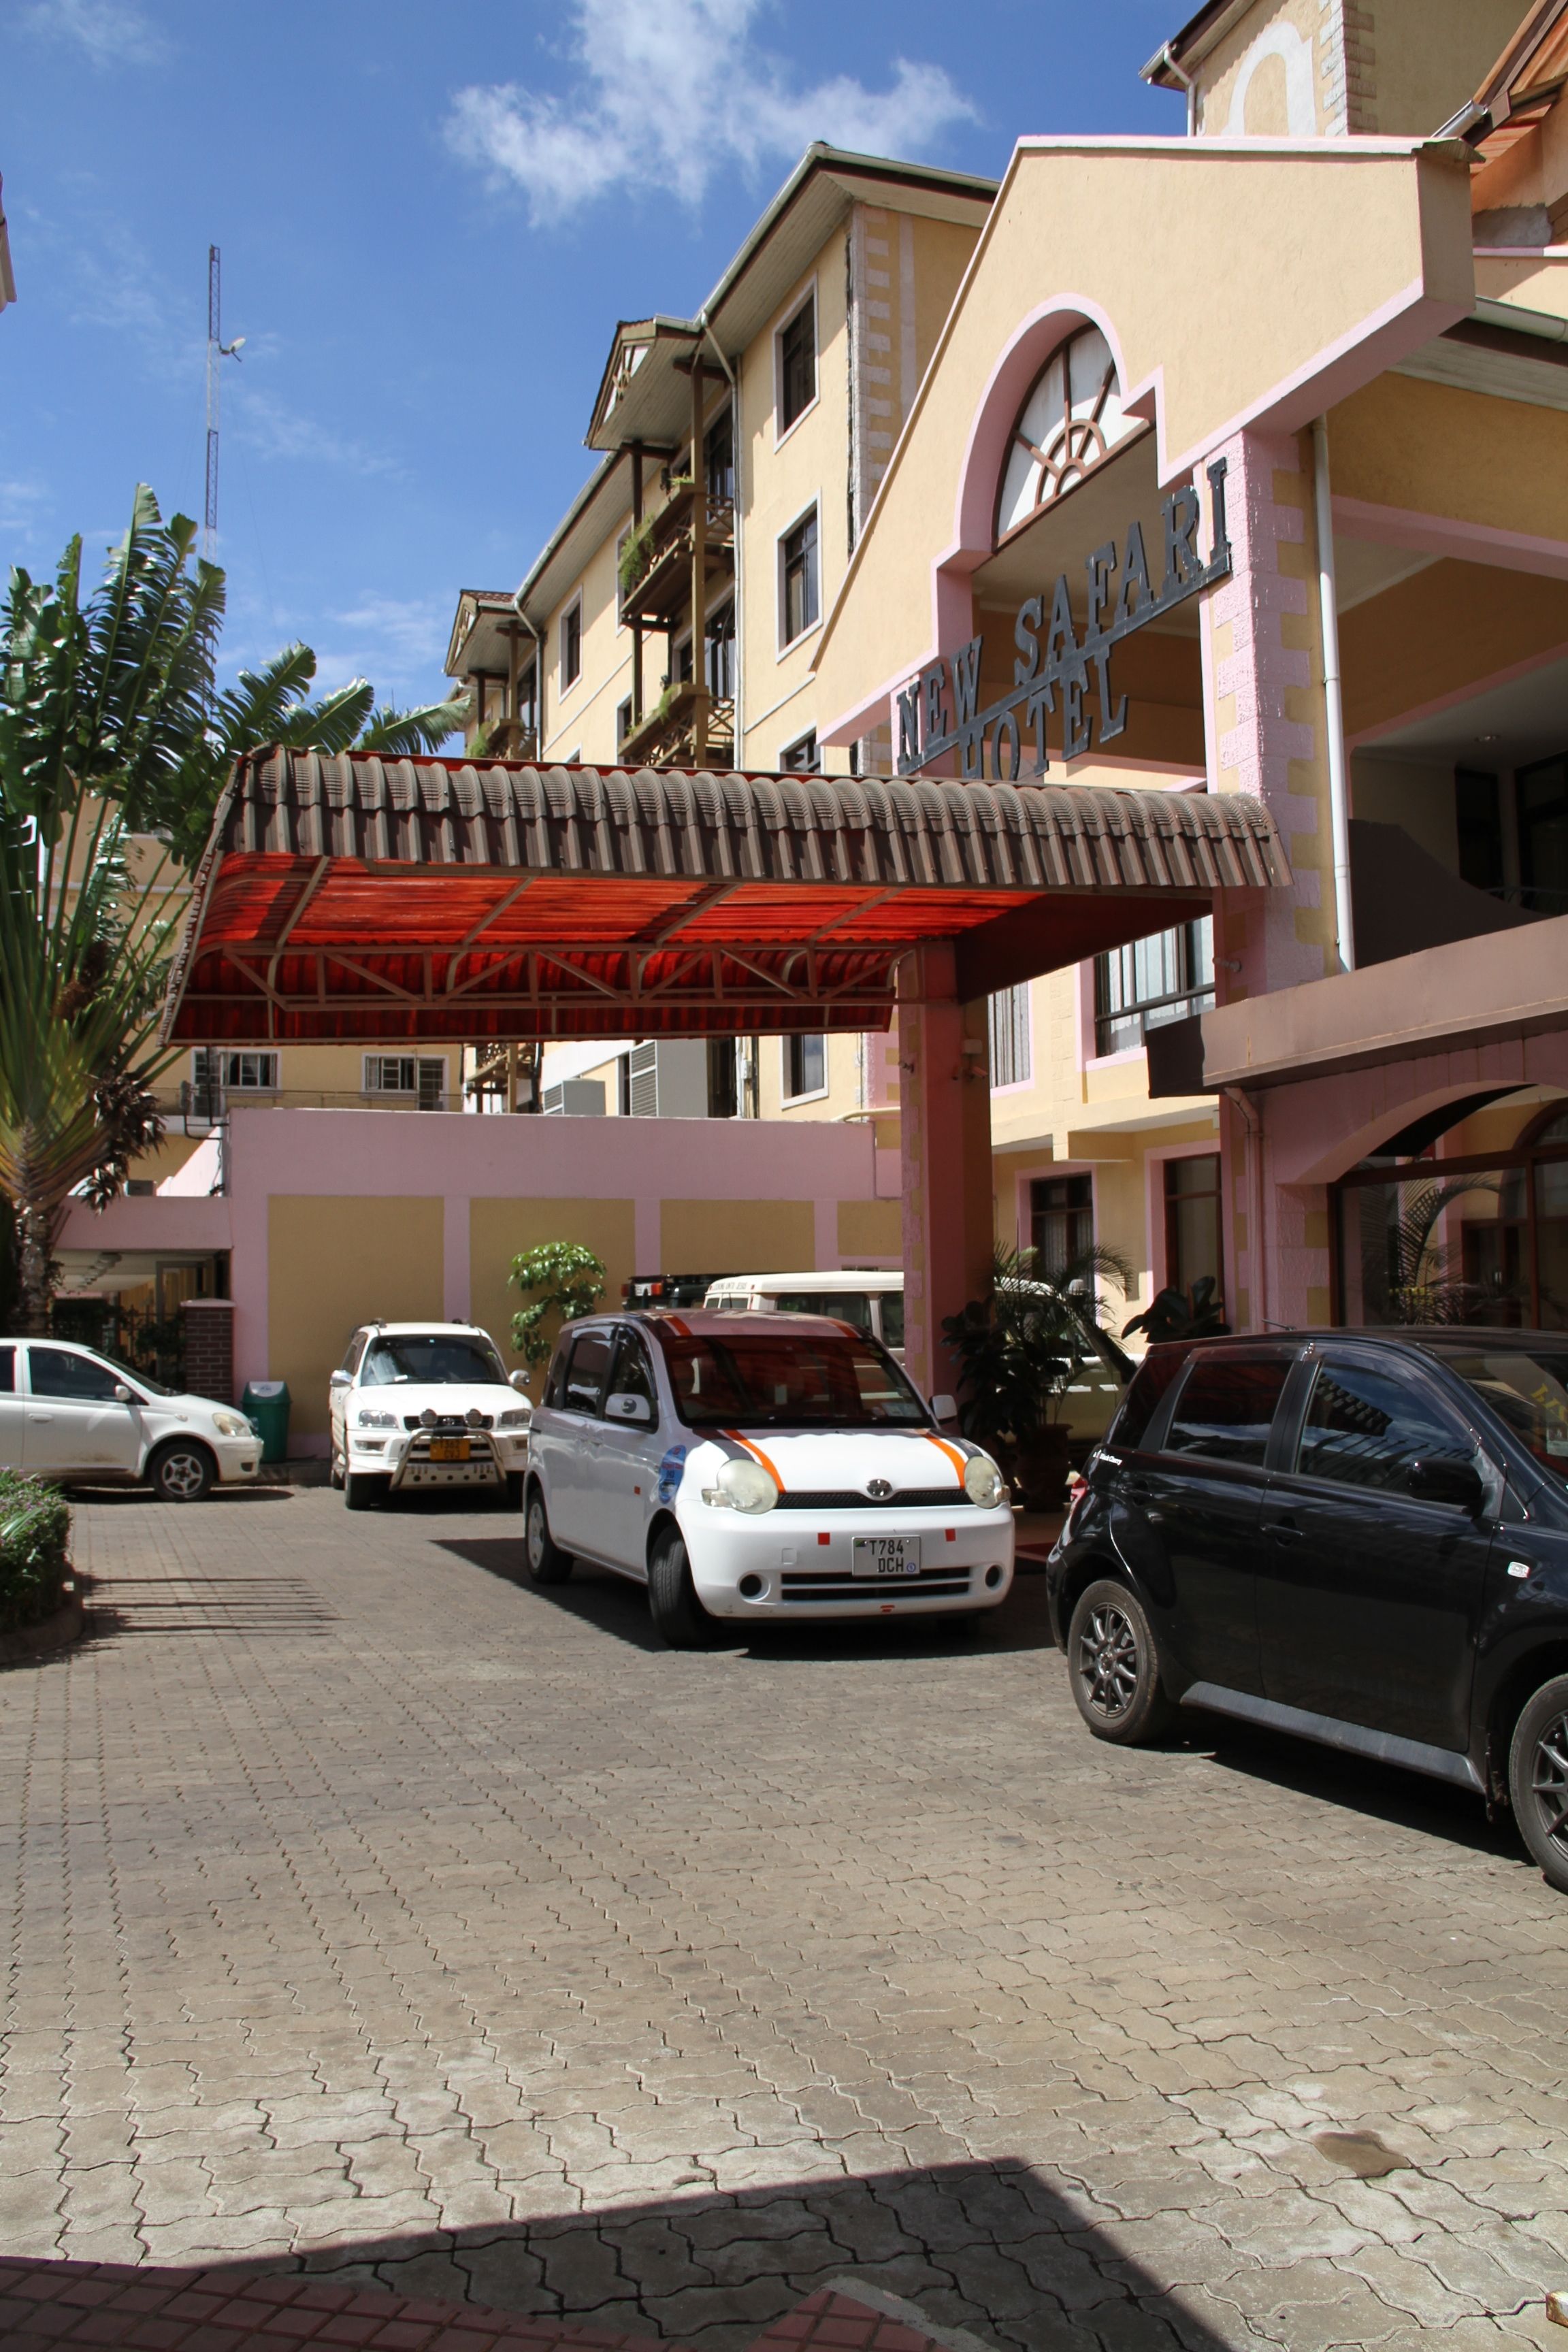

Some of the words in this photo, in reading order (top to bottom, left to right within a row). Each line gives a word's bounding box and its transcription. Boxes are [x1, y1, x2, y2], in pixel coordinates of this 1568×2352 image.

[896, 634, 983, 765] NEW
[1013, 456, 1232, 686] SAFARI
[960, 645, 1128, 781] HOTEL
[869, 1539, 903, 1555] T784
[878, 1557, 904, 1573] DCH
